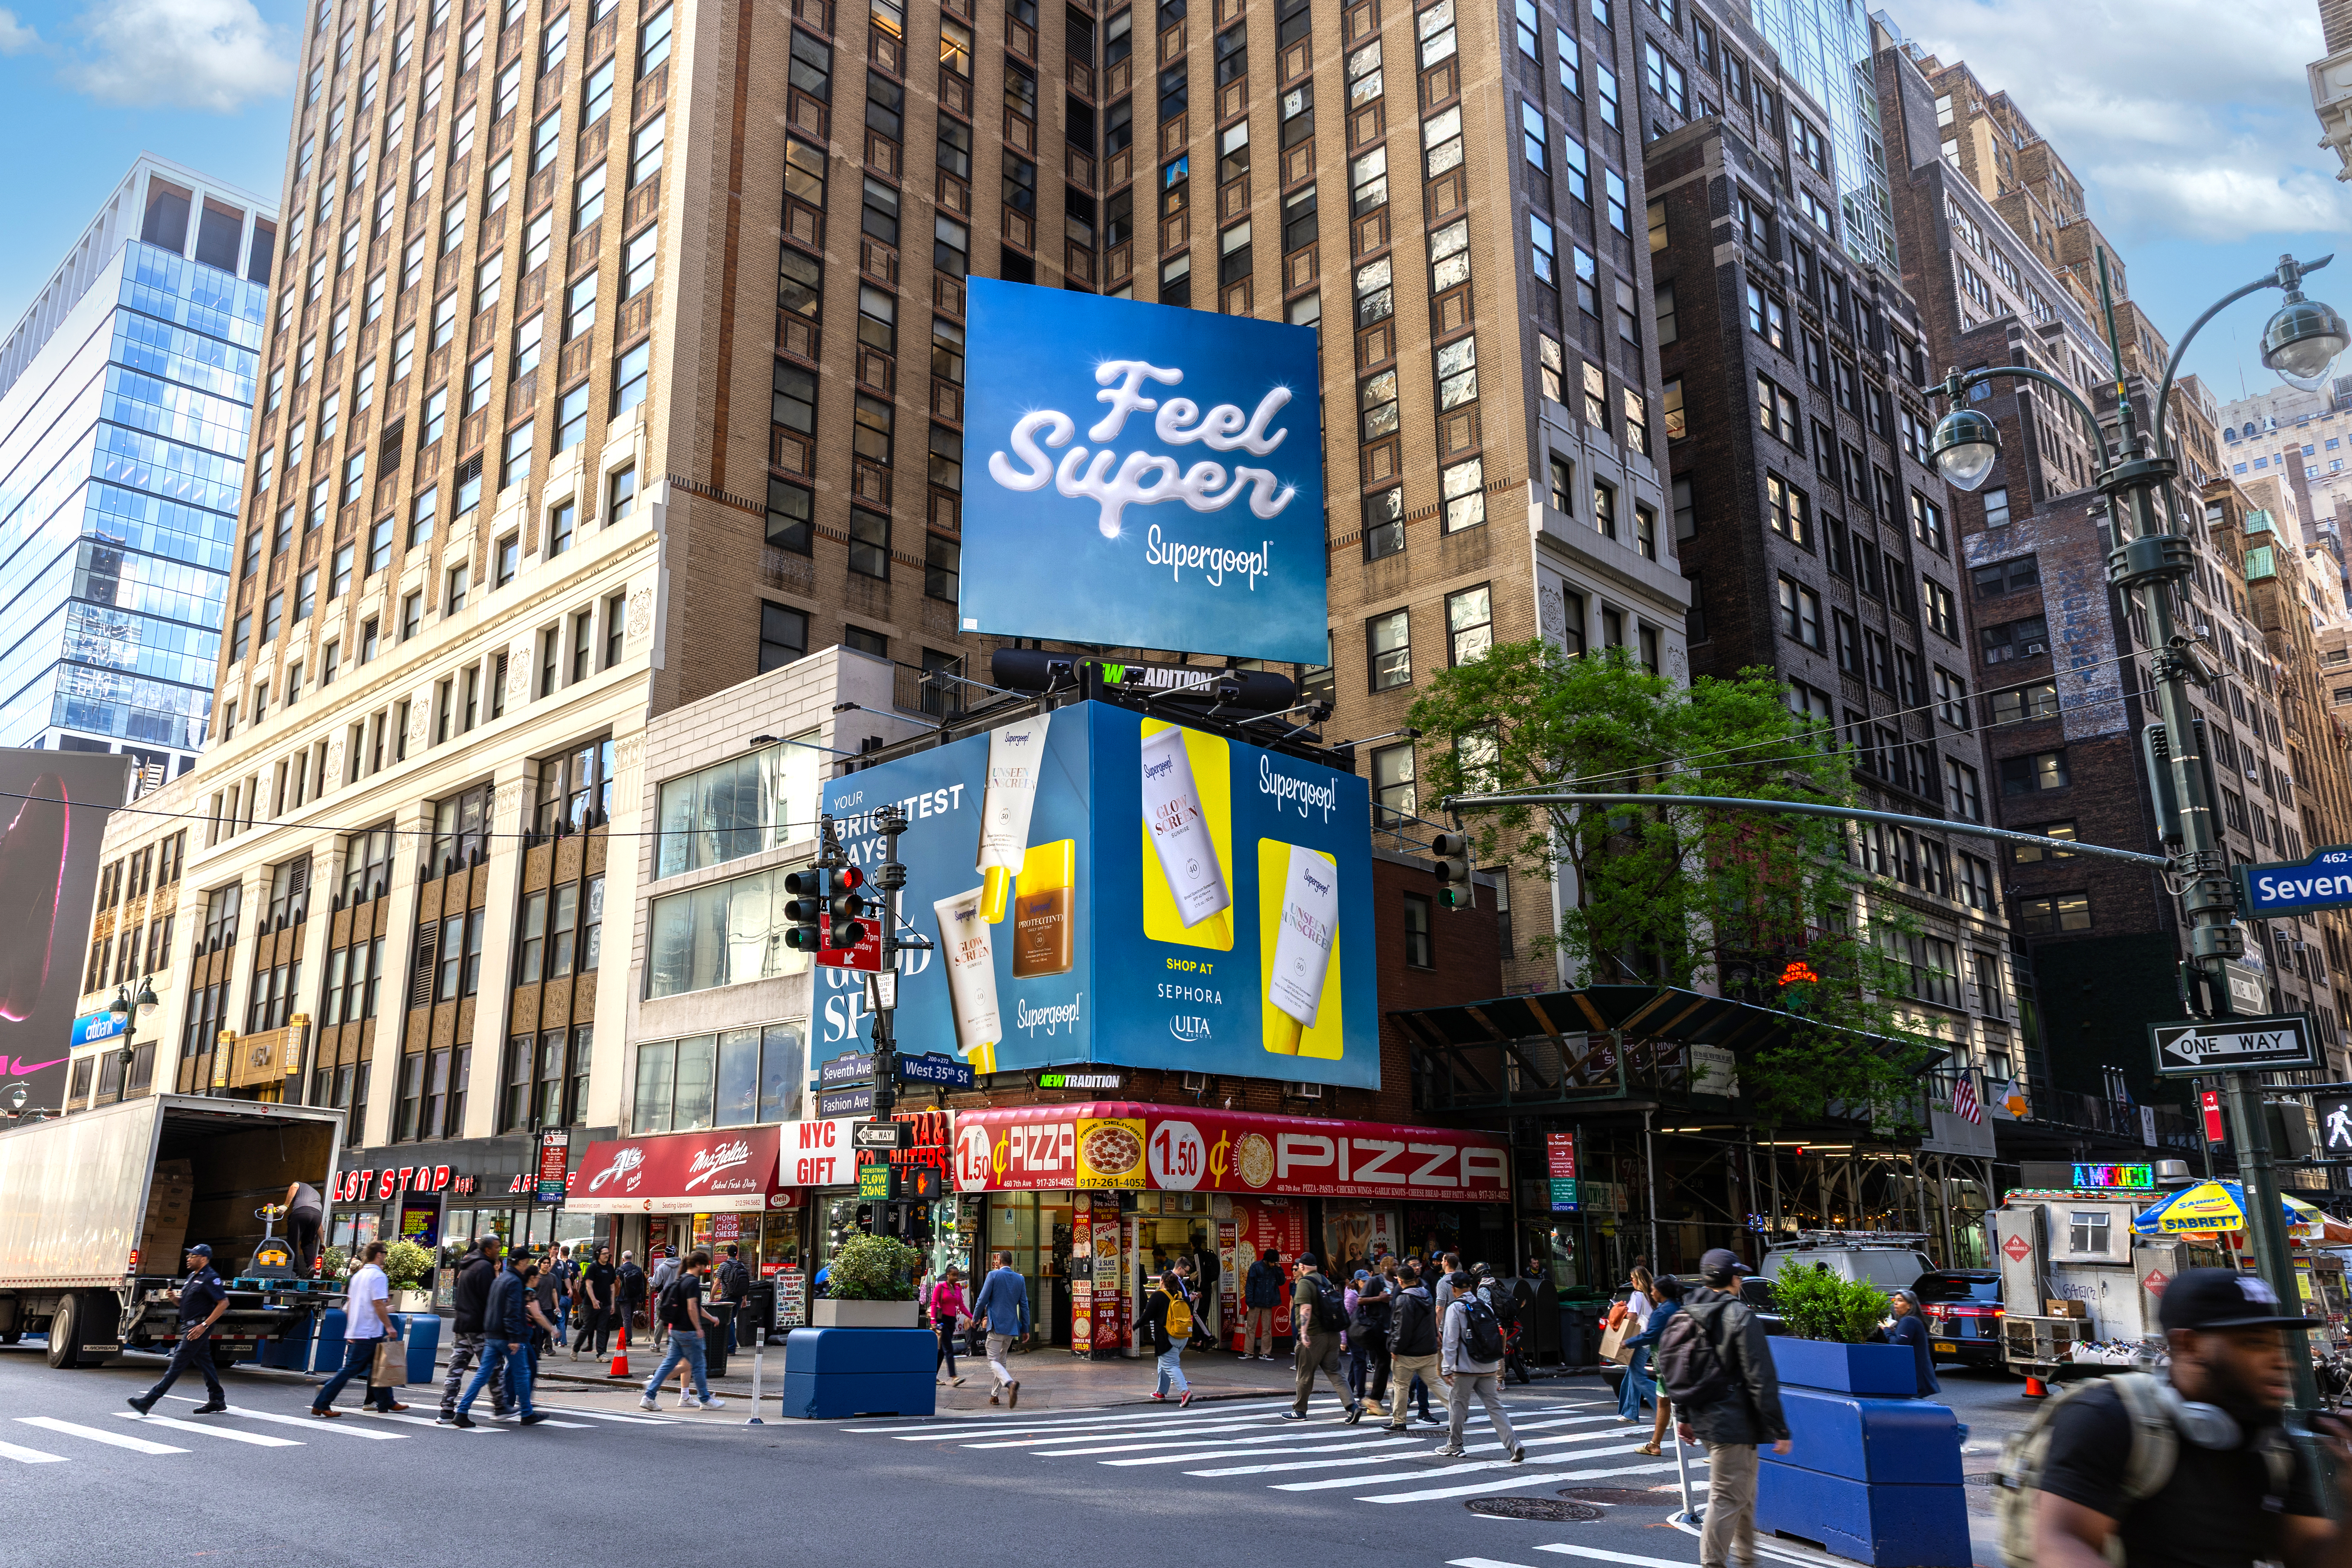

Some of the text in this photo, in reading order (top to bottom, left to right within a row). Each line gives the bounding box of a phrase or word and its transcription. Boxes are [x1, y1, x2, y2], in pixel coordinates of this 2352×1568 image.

[1089, 360, 1292, 457] Feel
[988, 410, 1295, 539] Super
[1146, 524, 1268, 591] Supergoop!
[1005, 731, 1030, 746] Supergoop!
[993, 767, 1030, 777] UNSEEN
[1144, 754, 1173, 781] Supergoop!
[1259, 754, 1335, 824] Supergoop!
[834, 791, 863, 811] YOUR
[1156, 794, 1187, 820] GLOW
[1155, 805, 1198, 836] SCREEN
[1171, 825, 1190, 838] SUNRISE
[832, 836, 887, 866] AYS
[1189, 864, 1197, 874] 40
[1304, 868, 1328, 897] Supergoop!
[955, 905, 977, 923] Supergoop!
[1018, 913, 1064, 929] PROTEC(TINT)
[1290, 902, 1328, 937] UNSEEN
[1281, 909, 1333, 954] SUNSCREEN
[853, 943, 872, 952] unday
[958, 936, 984, 953] GLOW
[955, 946, 990, 966] SCREEN
[967, 961, 982, 969] SUNRISE
[1166, 958, 1213, 975] SHOP AT
[1296, 962, 1304, 971] 50
[1158, 983, 1222, 1005] SEPHORA
[2233, 979, 2261, 1002] ONE WAY
[1017, 993, 1080, 1038] Supergoop!
[1175, 1015, 1210, 1035] ULTA
[86, 1017, 114, 1041] citibank
[2181, 1032, 2283, 1055] ONE WAY
[250, 1044, 270, 1068] 450
[824, 1063, 854, 1081] Seventh
[856, 1062, 871, 1075] Ave
[906, 1060, 968, 1084] West 35th St
[823, 1095, 869, 1113] Fashion Ave
[799, 1121, 835, 1149] NYC
[862, 1131, 892, 1140] ONE WAY
[1080, 1121, 1144, 1141] FREE DELIVERY
[957, 1123, 1075, 1180] 1.50 PIZZA
[1155, 1129, 1197, 1176] 1.50
[1232, 1131, 1248, 1177] Delicious
[1277, 1133, 1508, 1189] PIZZA
[589, 1147, 646, 1192] Al's
[796, 1157, 836, 1184] GIFT
[855, 1146, 946, 1183] COPUTERS
[379, 1164, 450, 1200] STOP
[455, 1175, 473, 1197] Dept
[627, 1170, 642, 1187] Deli
[711, 1178, 757, 1192] Baked Fresh Daily
[862, 1174, 887, 1184] FLOW
[1037, 1178, 1075, 1187] 917-261-4052
[1080, 1178, 1145, 1188] 917-261-4052
[2088, 1167, 2152, 1187] MEXICO
[774, 1195, 787, 1203] Deli
[862, 1185, 886, 1196] ZONE
[1303, 1184, 1317, 1192] PIZZA
[1319, 1184, 1334, 1193] PASTA
[1337, 1185, 1357, 1194] CHICKEN
[1357, 1186, 1372, 1195] WINGS
[1375, 1187, 1391, 1195] GARLIC
[1391, 1188, 1406, 1196] KNOTS
[1408, 1189, 1425, 1197] CHEESE
[1425, 1190, 1439, 1198] BREAD
[1441, 1190, 1451, 1198] BEEF
[1452, 1191, 1464, 1199] PATTY
[1467, 1191, 1477, 1199] SODA
[1479, 1190, 1509, 1200] 917-261-4052
[662, 1202, 676, 1210] Seating
[677, 1201, 693, 1209] Upstairs
[2178, 1196, 2226, 1209] SABRETT
[1095, 1221, 1118, 1236] SPECIAL
[2165, 1214, 2239, 1230] SABRETT
